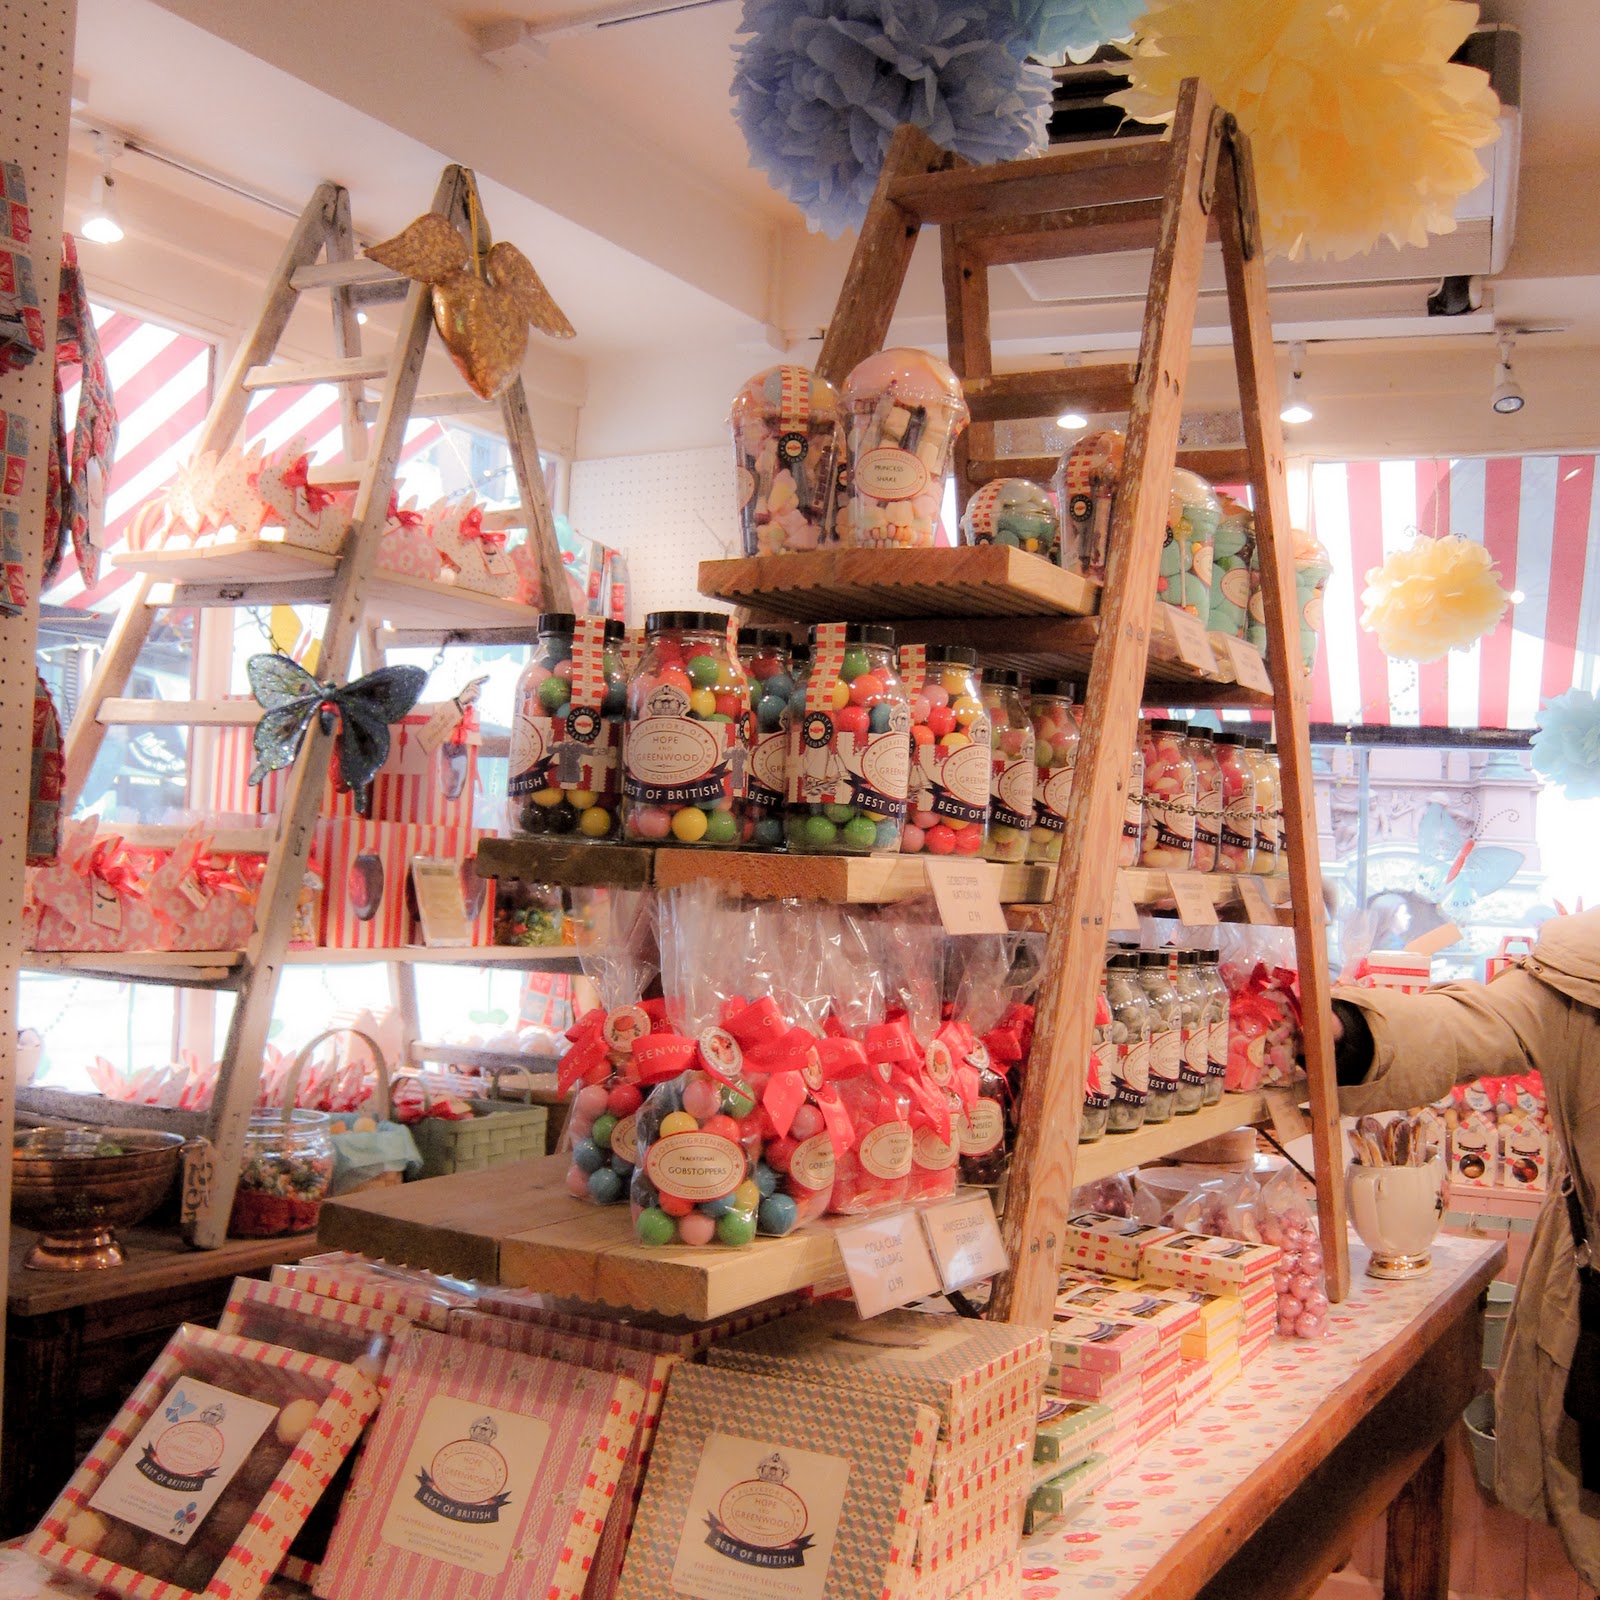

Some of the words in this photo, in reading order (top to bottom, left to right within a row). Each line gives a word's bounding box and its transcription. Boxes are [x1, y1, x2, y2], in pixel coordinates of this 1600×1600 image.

[568, 706, 600, 722] QUALITY
[804, 712, 832, 728] QUALITY
[567, 724, 600, 742] ASSURED
[652, 736, 679, 745] HOPE
[804, 733, 832, 748] ASSURED
[636, 753, 700, 762] GREENWOOD
[624, 781, 642, 797] BEST
[645, 789, 662, 800] OF
[667, 783, 719, 800] BRITISH
[748, 789, 777, 805] BEST
[857, 793, 885, 810] BEST
[889, 803, 900, 813] OF
[938, 801, 965, 816] BEST
[968, 809, 981, 819] OF
[995, 811, 1017, 825] BEST
[1019, 819, 1028, 828] OF
[1040, 816, 1065, 830] BEST
[1161, 834, 1179, 846] BEST
[1182, 840, 1191, 848] OF
[1222, 834, 1240, 846] BEST
[1242, 838, 1250, 847] OF
[1259, 840, 1274, 851] BEST
[638, 1043, 697, 1063] EENWO
[868, 1040, 901, 1052] GREE
[1182, 1072, 1199, 1083] BEST
[1208, 1066, 1221, 1075] EST
[1119, 1091, 1138, 1103] BEST
[654, 1140, 676, 1158] HOPE
[686, 1137, 739, 1161] GREENWOOD
[668, 1166, 726, 1175] GOBSTOPPERS
[966, 1214, 985, 1229] BALLS
[864, 1238, 886, 1254] COLA
[284, 1408, 359, 1523] GREENWOOD
[463, 1456, 483, 1467] HOPE
[142, 1463, 158, 1476] BEST
[157, 1473, 168, 1482] OF
[167, 1478, 197, 1488] BRITISH
[444, 1466, 492, 1486] GREENWOOD
[579, 1413, 628, 1546] GREENWOOD
[423, 1492, 441, 1508] BEST
[442, 1505, 455, 1514] OF
[456, 1508, 491, 1520] BRITISH
[755, 1498, 778, 1509] HOPE
[735, 1510, 791, 1529] GREENWOOD
[463, 1532, 501, 1550] SELECTION
[714, 1537, 736, 1554] BEST
[739, 1550, 753, 1560] OF
[756, 1554, 795, 1564] BRITISH
[760, 1578, 802, 1594] SELECTION
